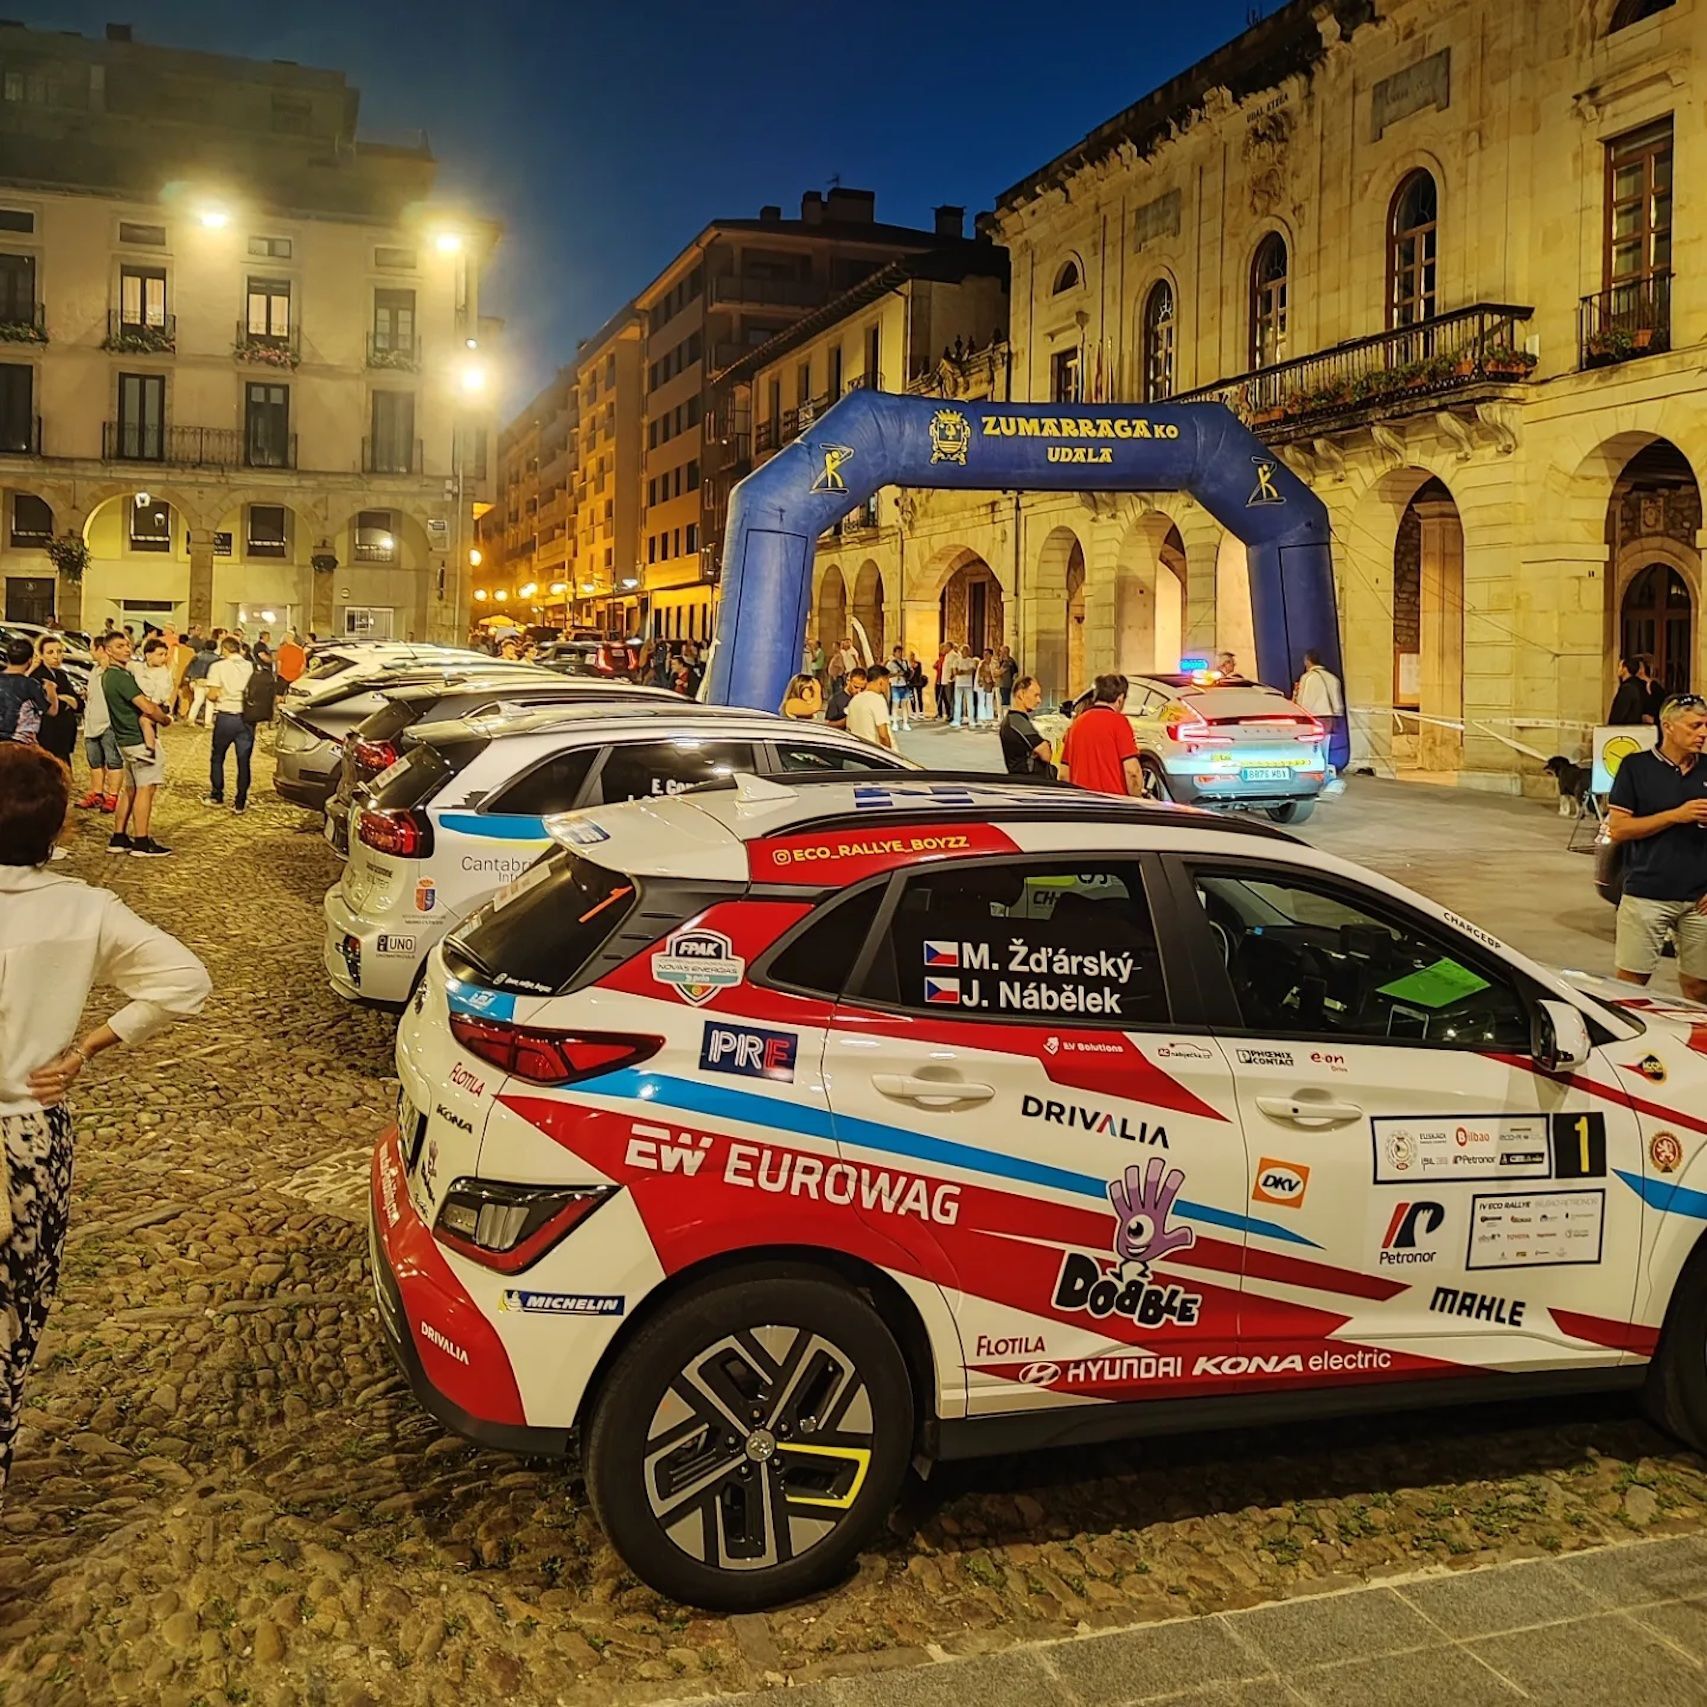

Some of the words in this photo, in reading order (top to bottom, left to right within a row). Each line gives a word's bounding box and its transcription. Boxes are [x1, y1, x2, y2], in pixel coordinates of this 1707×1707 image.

[981, 416, 1152, 439] ZUMARRAGA
[1153, 424, 1179, 439] KO
[1047, 446, 1113, 463] UDALA
[651, 778, 664, 794] E.
[793, 836, 970, 862] ECO_RALLYE_BOYZZ
[389, 938, 413, 950] UNO
[679, 941, 718, 957] FPAK
[962, 942, 999, 971] M.
[1008, 938, 1134, 983] Žďárský
[962, 979, 989, 1007] J.
[999, 980, 1122, 1014] Nábělek
[708, 1029, 790, 1070] PRE
[1077, 1042, 1124, 1053] Solutions
[450, 1062, 486, 1098] FLOTILA
[436, 1104, 473, 1134] KONA
[1021, 1095, 1170, 1149] DRIVALIA
[1456, 1127, 1490, 1147] Bilbao
[1575, 1116, 1590, 1173] 1
[1463, 1155, 1496, 1165] Petronor
[723, 1143, 962, 1225] EUROWAG
[1262, 1174, 1301, 1192] DKV
[1379, 1251, 1436, 1265] Petronor
[526, 1295, 618, 1311] MICHELIN
[1429, 1286, 1526, 1327] MAHLE
[421, 1321, 469, 1365] DRIVALIA
[976, 1335, 1045, 1356] FLOTILA
[1067, 1356, 1182, 1383] HYUNDAI
[1192, 1354, 1304, 1376] KONA
[1308, 1351, 1391, 1371] electric
